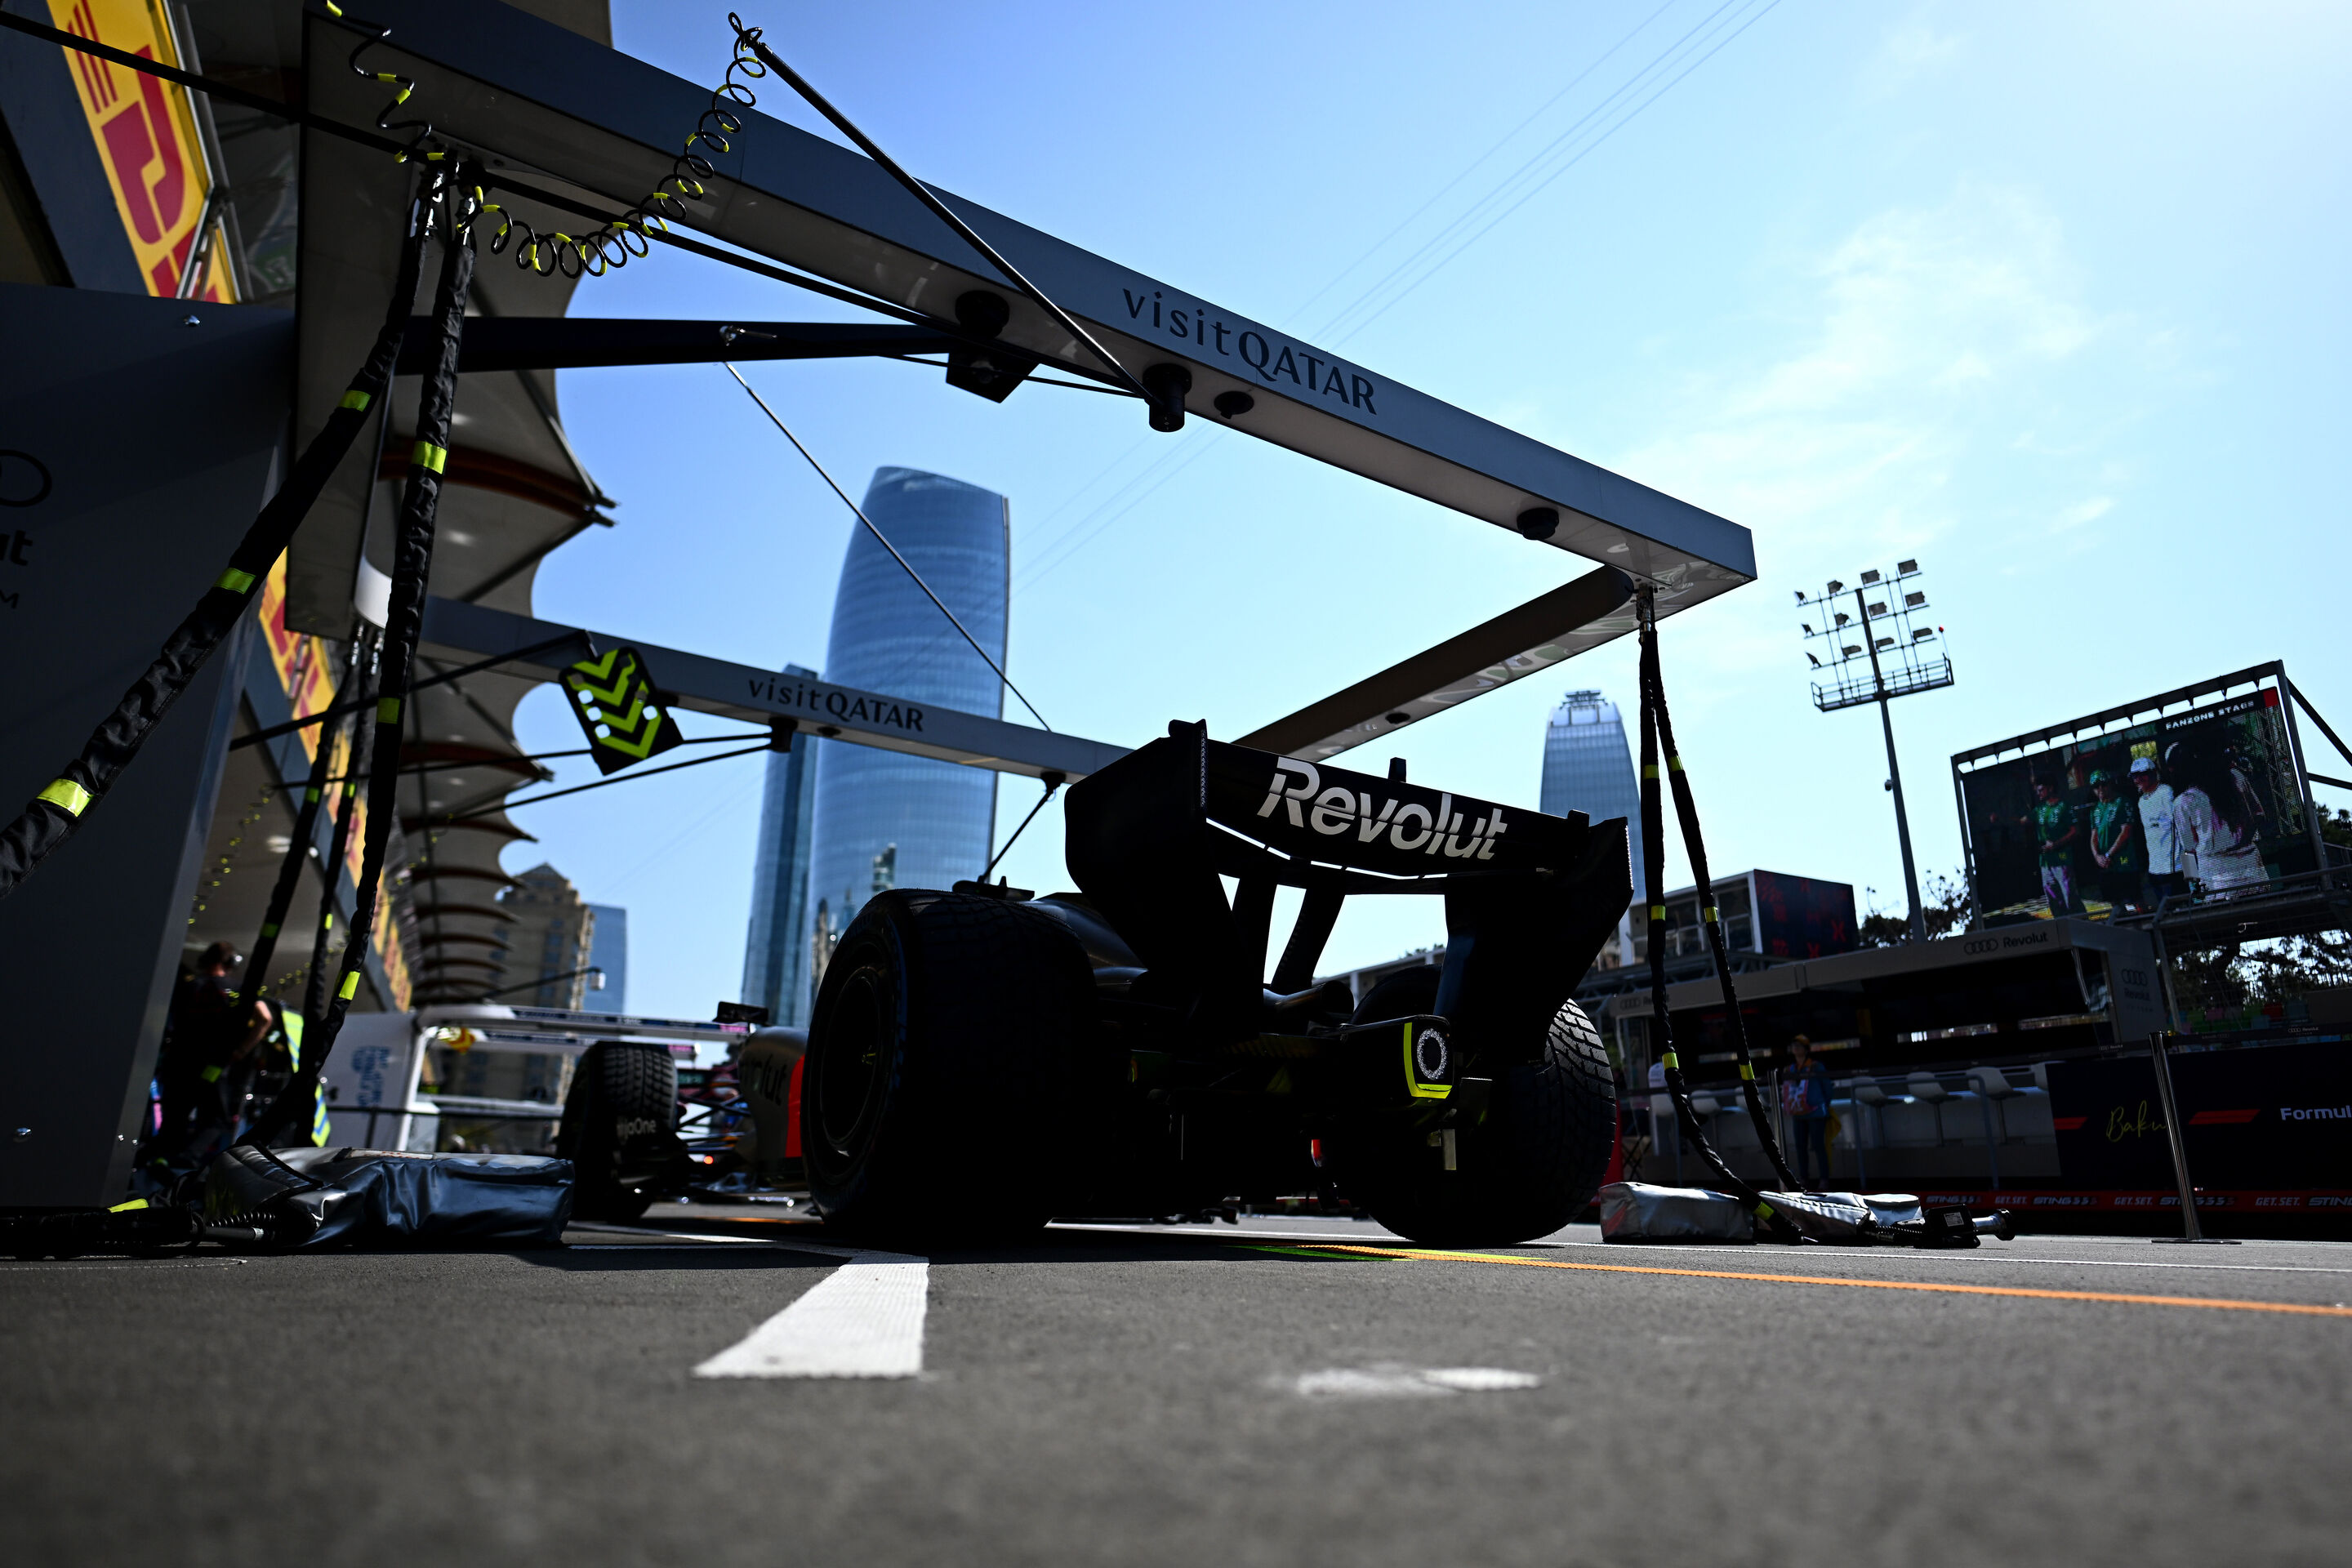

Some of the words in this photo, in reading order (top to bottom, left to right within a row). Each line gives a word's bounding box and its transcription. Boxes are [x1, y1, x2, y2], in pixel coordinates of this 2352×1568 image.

[1123, 288, 1377, 415] visitQATAR
[749, 678, 923, 732] visitQATAR
[2165, 710, 2215, 731] FANZONE
[2217, 701, 2254, 716] STAGE
[1256, 756, 1508, 861] Revolut
[2003, 932, 2048, 948] Revolut
[2106, 1099, 2167, 1143] Baku
[2280, 1104, 2352, 1121] Formul
